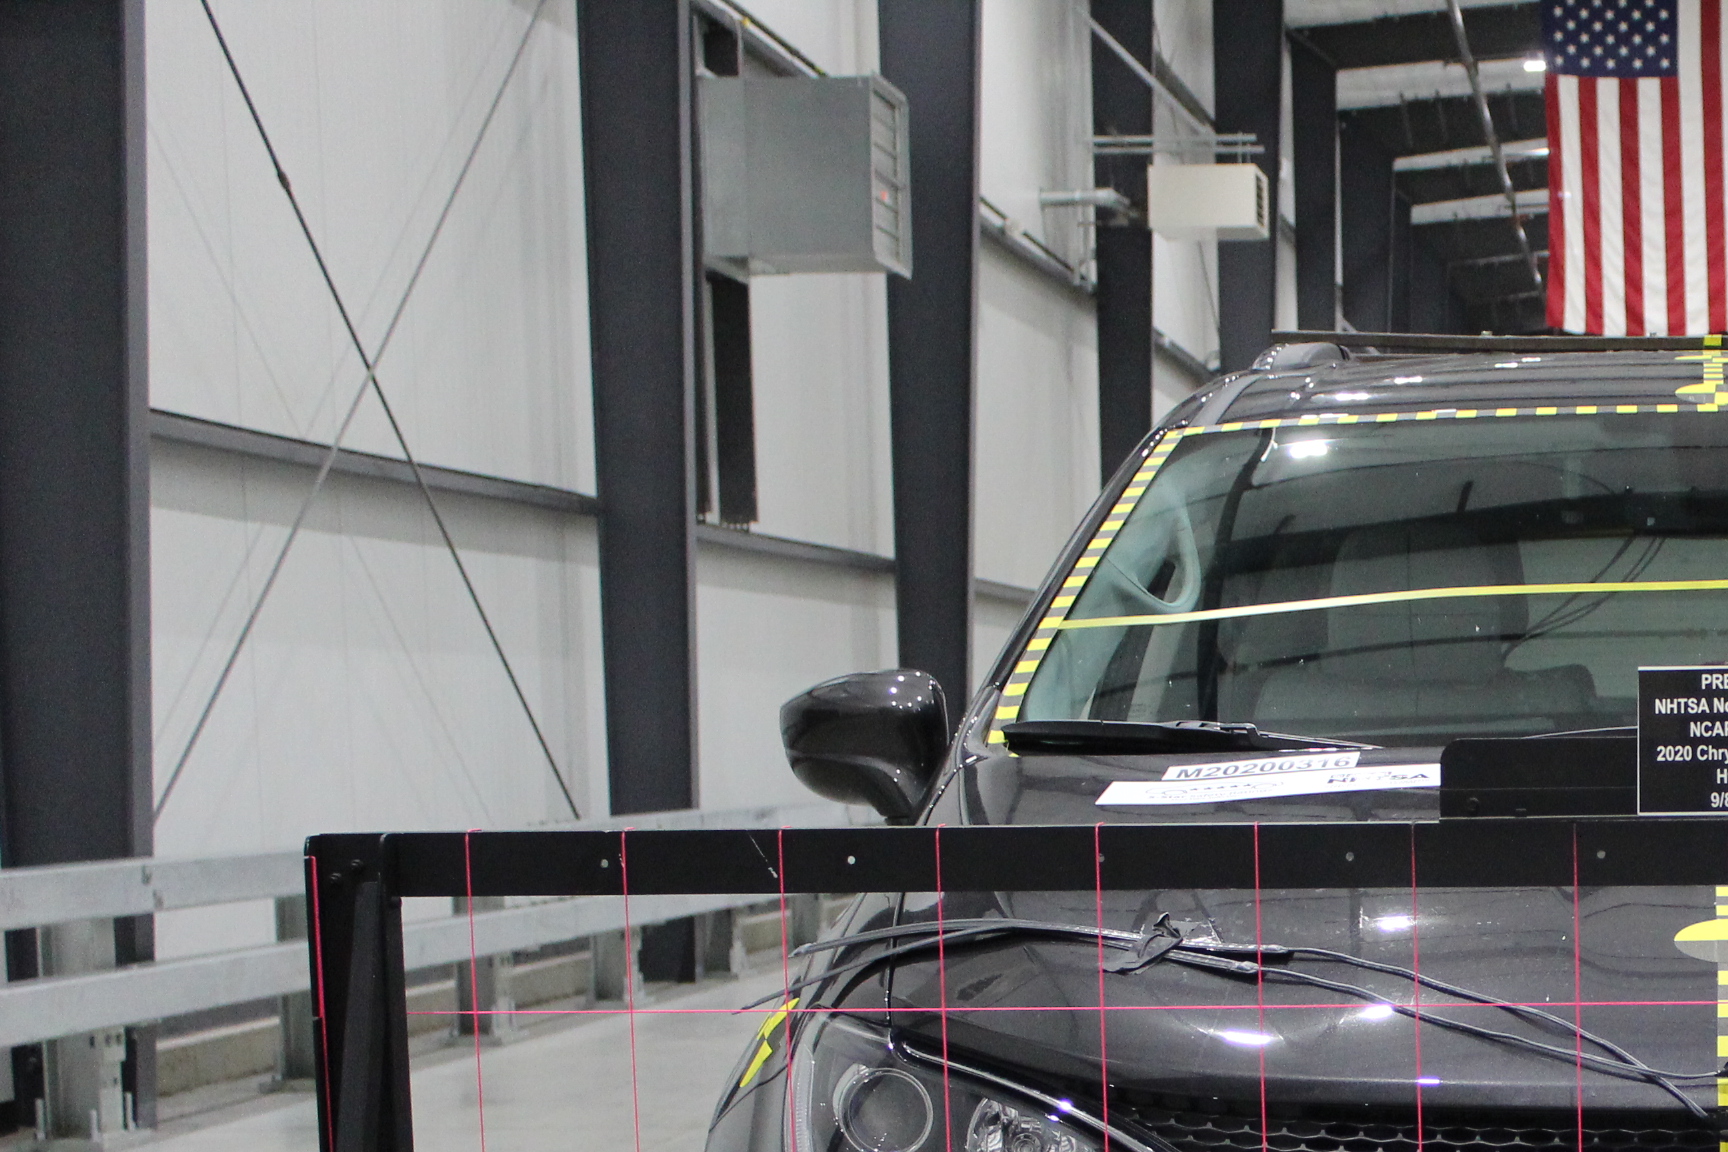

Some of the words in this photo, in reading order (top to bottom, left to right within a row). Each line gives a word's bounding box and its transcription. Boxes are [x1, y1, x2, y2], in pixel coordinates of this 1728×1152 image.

[1655, 698, 1710, 714] NHTSA
[1656, 745, 1693, 761] 2020
[1175, 756, 1351, 778] M20200316
[1327, 773, 1430, 784] NSA
